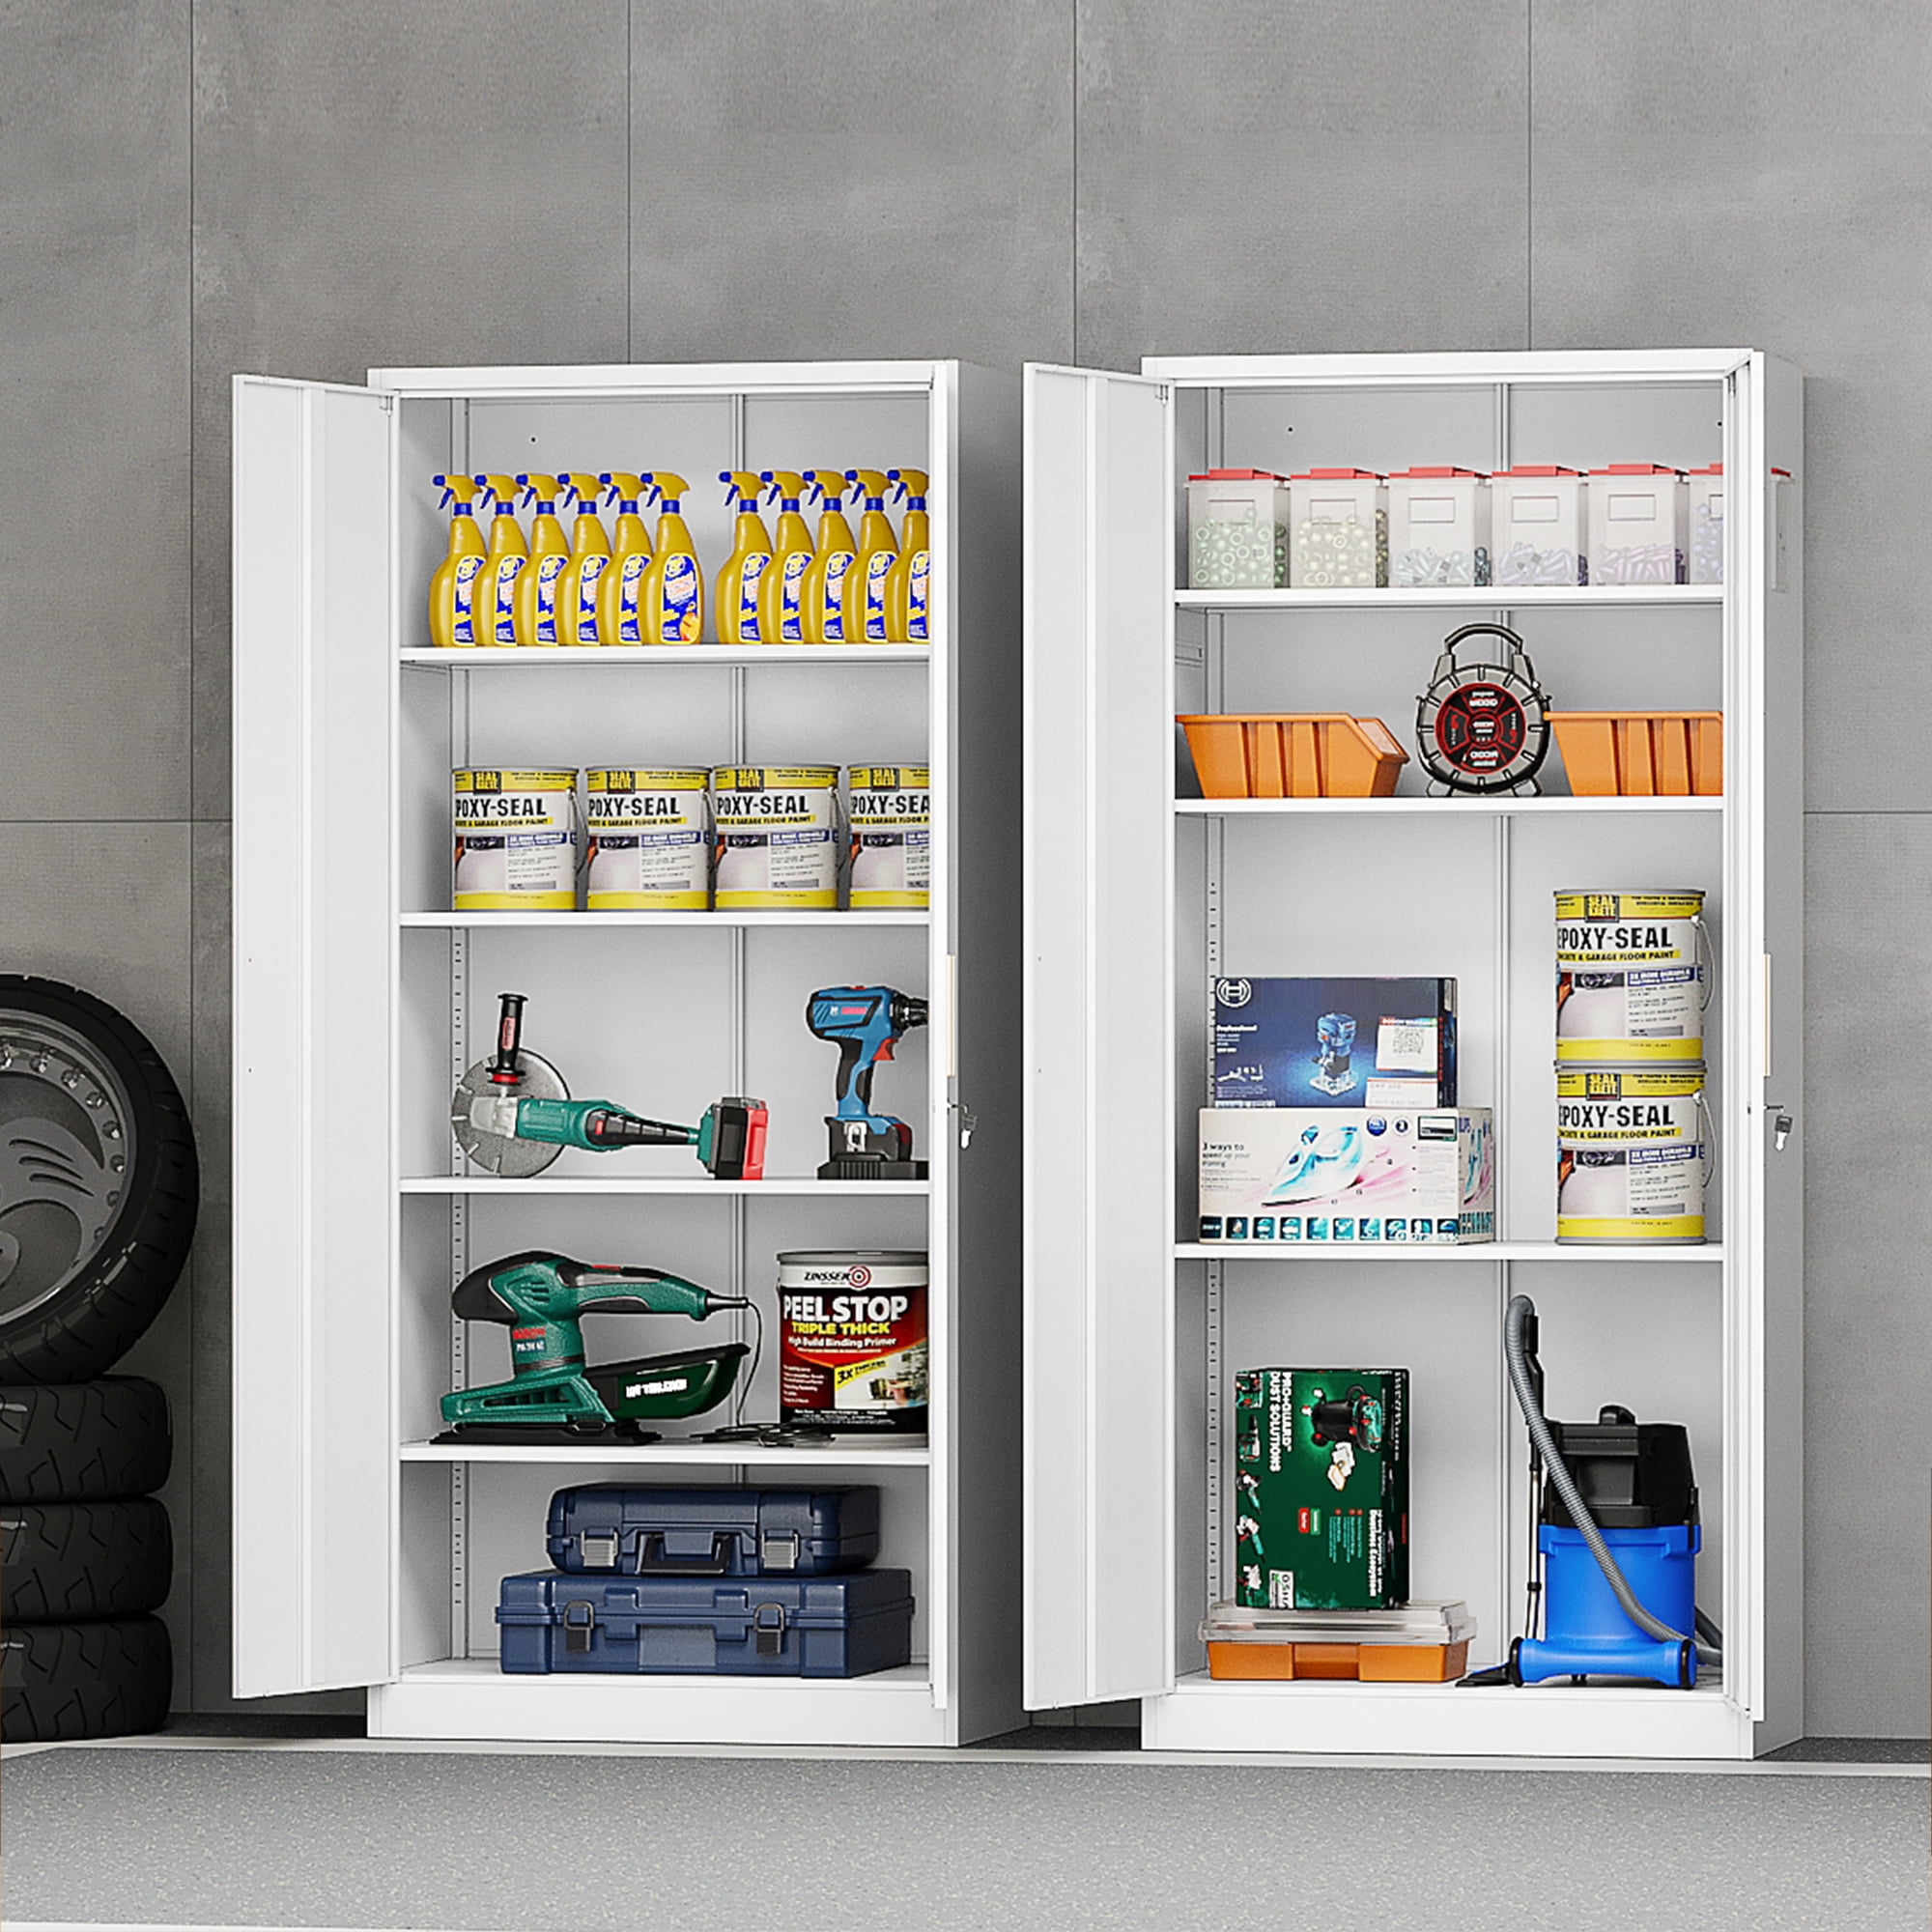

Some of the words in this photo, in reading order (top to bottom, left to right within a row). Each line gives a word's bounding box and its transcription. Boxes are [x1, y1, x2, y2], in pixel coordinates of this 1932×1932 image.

[455, 798, 547, 817] POXY-SEAL
[588, 797, 680, 817] POXY-SEAL
[717, 795, 810, 815] POXY-SEAL
[850, 795, 929, 814] POXY-SEA
[1585, 952, 1617, 961] GARAGE
[1619, 952, 1646, 961] FLOOR
[1648, 951, 1674, 959] PAINT
[1587, 1130, 1618, 1139] GARAGE
[1620, 1130, 1648, 1139] FLOOR
[1650, 1128, 1675, 1137] PAINT
[783, 1295, 830, 1322] PEEL
[832, 1295, 908, 1322] STOP
[791, 1321, 837, 1334] TRIPLE
[839, 1321, 891, 1335] THICK
[865, 1337, 897, 1347] Primer
[838, 1367, 854, 1384] 3X
[1269, 1404, 1281, 1472] SOLUTIONS
